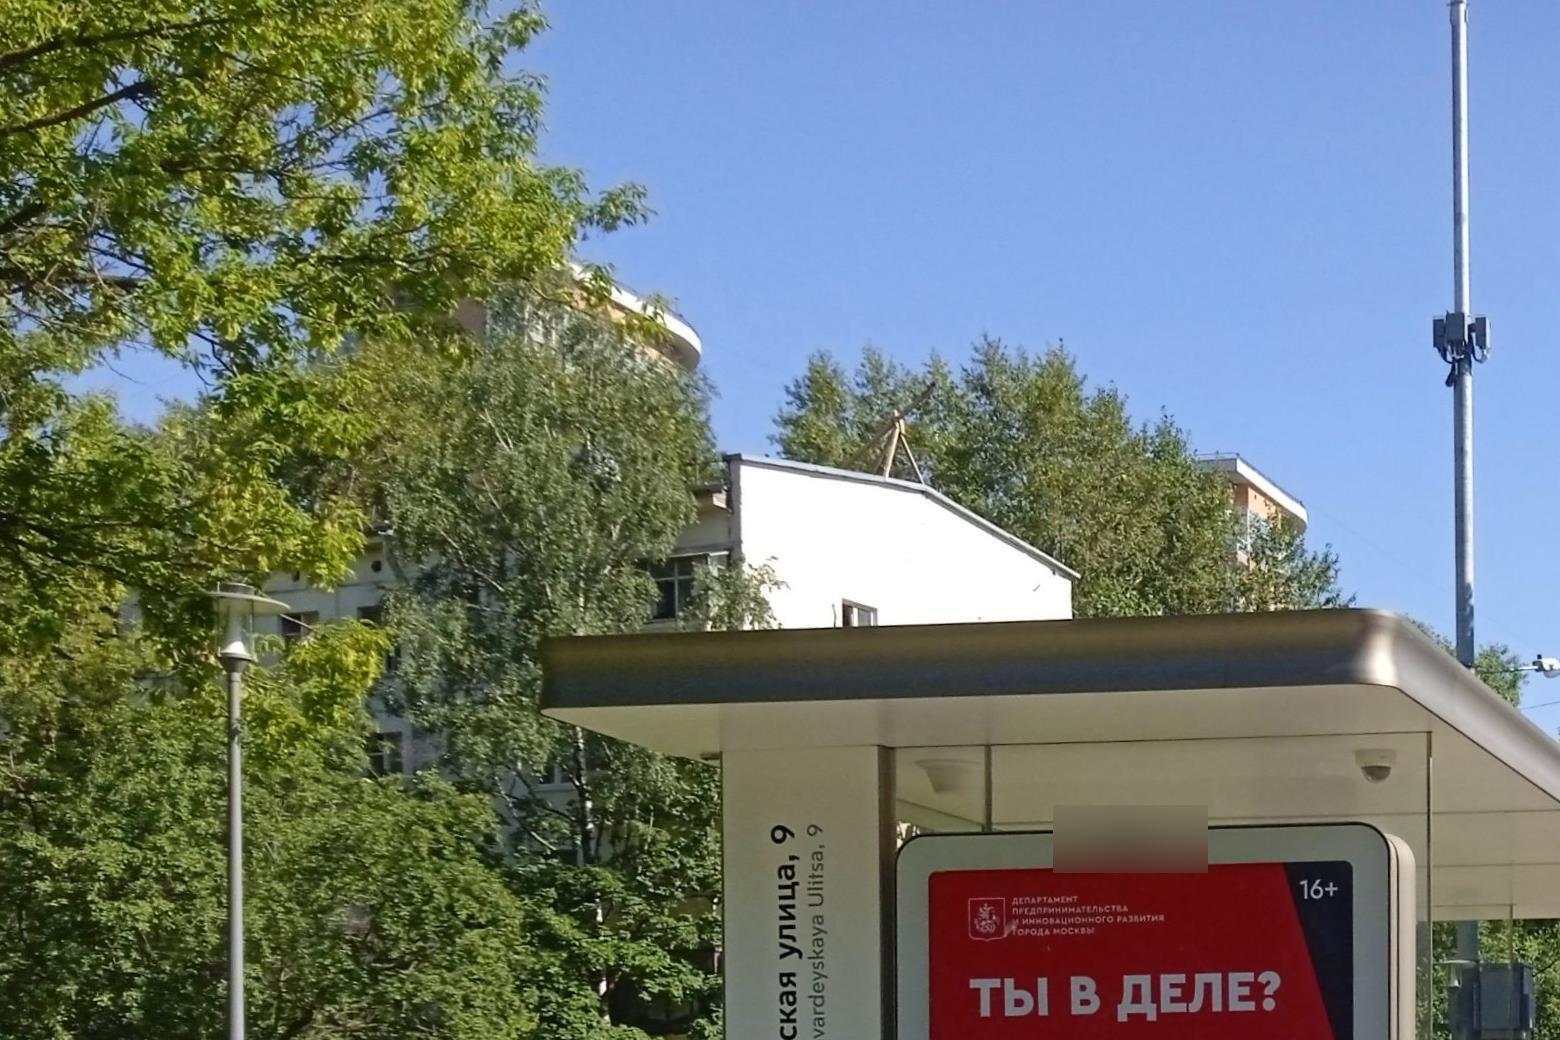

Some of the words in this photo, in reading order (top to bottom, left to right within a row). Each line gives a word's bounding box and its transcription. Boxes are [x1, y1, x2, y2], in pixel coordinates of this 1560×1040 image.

[771, 824, 796, 845] 9
[806, 823, 823, 838] 9
[807, 844, 827, 907] Ulitsa,
[1300, 879, 1339, 900] 16+
[775, 855, 804, 960] улица,
[1012, 896, 1078, 905] ДЕПАРТАМЕНТ
[1021, 915, 1113, 925] ИННОВАЦИОННОГО
[1116, 914, 1165, 923] РАЗВИТИЯ
[1053, 926, 1095, 935] МОСКВЫ
[969, 977, 1048, 1017] ТЫ
[1071, 975, 1100, 1015] В
[1117, 970, 1281, 1022] ДЕЛЕ?
